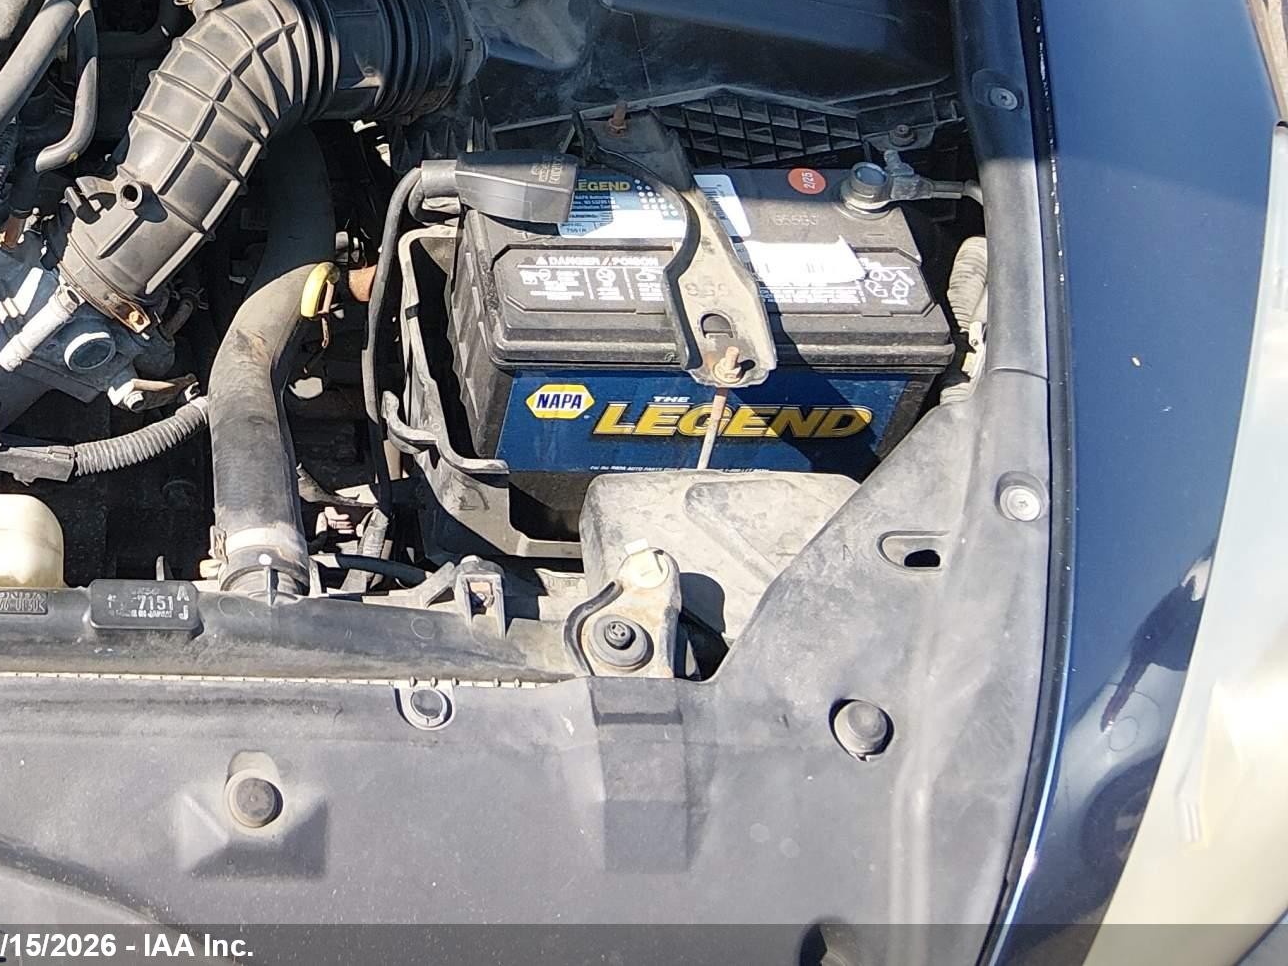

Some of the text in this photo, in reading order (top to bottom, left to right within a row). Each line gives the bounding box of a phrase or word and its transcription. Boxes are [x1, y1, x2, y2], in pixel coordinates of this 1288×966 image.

[575, 181, 630, 192] EGEND
[801, 172, 814, 189] 2/25
[547, 256, 601, 266] DANGER
[536, 392, 584, 411] NAPA
[652, 395, 692, 404] THE
[592, 401, 874, 439] LEGEND
